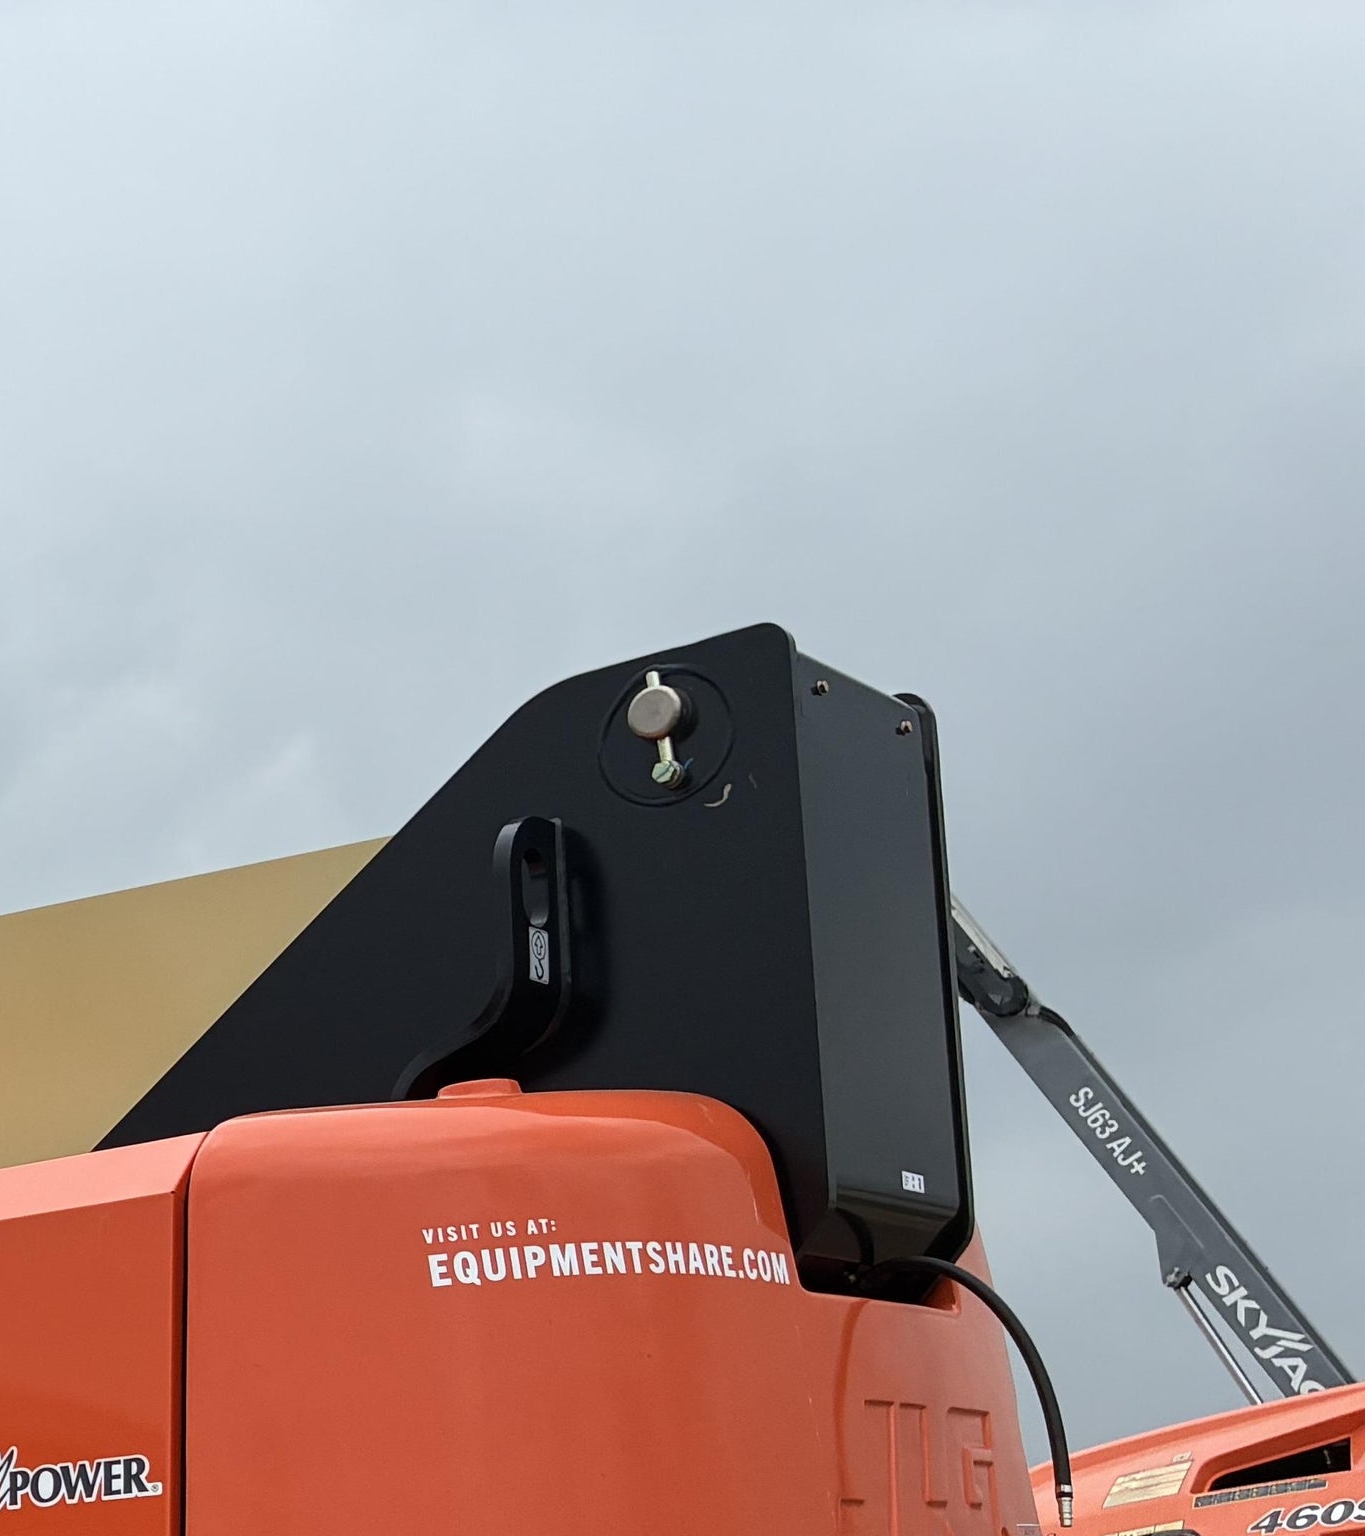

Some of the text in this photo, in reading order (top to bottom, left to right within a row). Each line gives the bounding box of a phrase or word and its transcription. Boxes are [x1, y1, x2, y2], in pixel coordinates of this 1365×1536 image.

[1070, 1087, 1119, 1139] SJ63
[421, 1219, 557, 1244] VISIT US AT:
[427, 1241, 790, 1287] EQUIPMENTSHARE.COM
